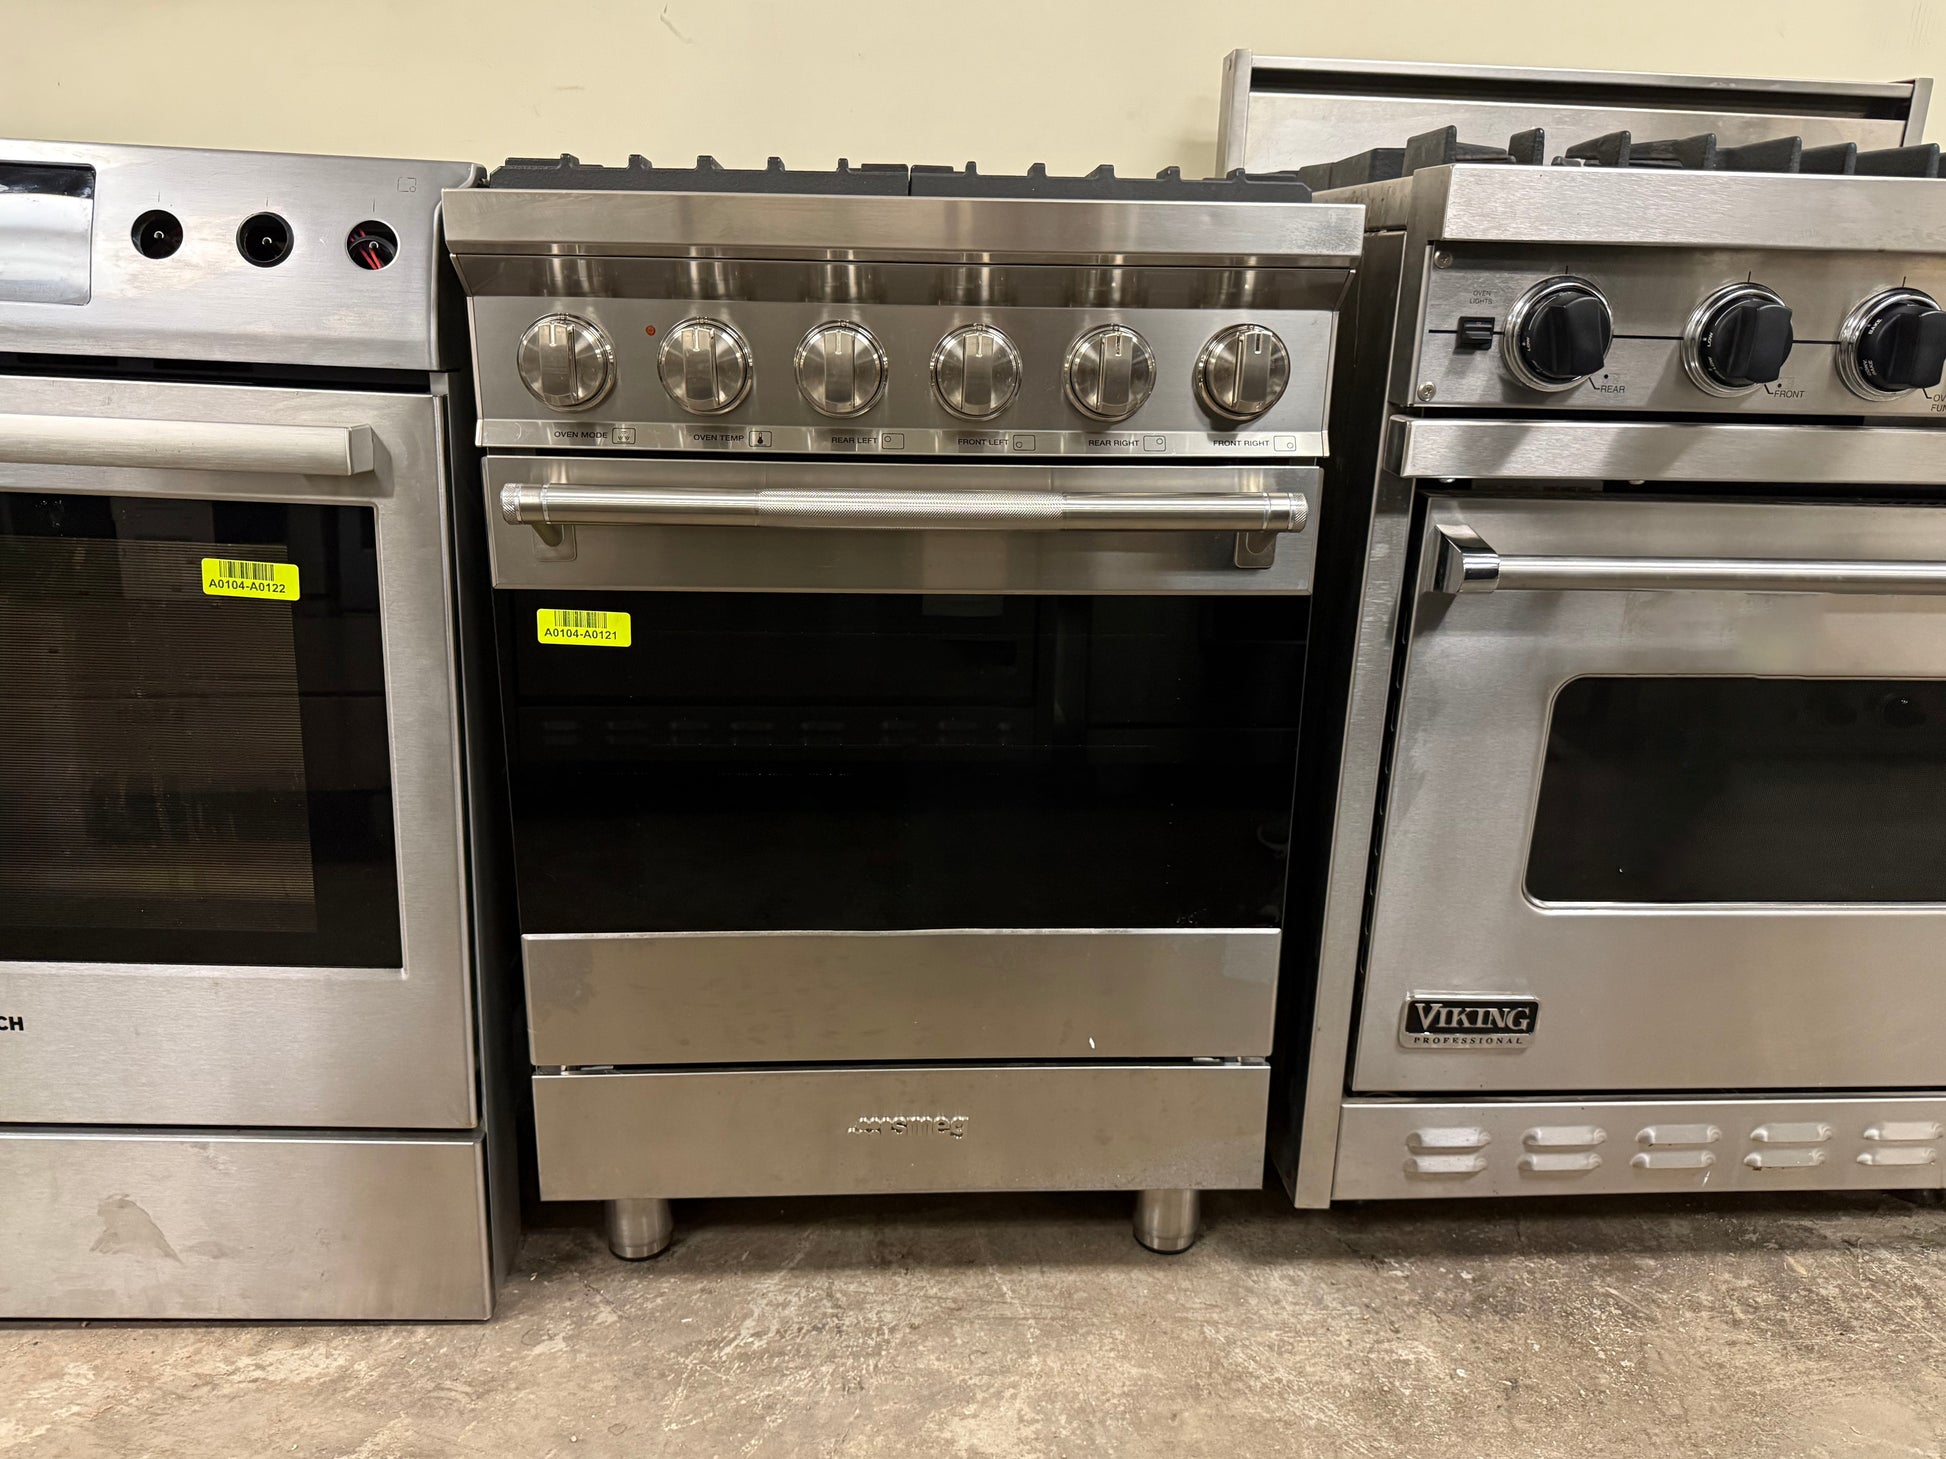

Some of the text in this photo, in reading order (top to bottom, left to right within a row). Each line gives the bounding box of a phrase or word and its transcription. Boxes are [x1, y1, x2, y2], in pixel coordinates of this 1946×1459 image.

[1706, 331, 1714, 347] LOW
[1600, 385, 1625, 393] REAR
[1773, 390, 1805, 398] FRONT
[554, 430, 608, 439] OVEN MODE
[693, 433, 744, 442] OVEN TEMP
[831, 436, 855, 444] REAR
[958, 438, 987, 446] FRONT
[1088, 439, 1139, 447] REAR RIGHT
[1213, 439, 1270, 447] FRONT RIGHT
[208, 578, 286, 593] A0104-A0122
[544, 627, 617, 640] A0104-A0121
[1415, 1003, 1530, 1031] VIKING
[1414, 1036, 1523, 1045] PROFESSIONAL
[891, 1115, 969, 1140] smeg
